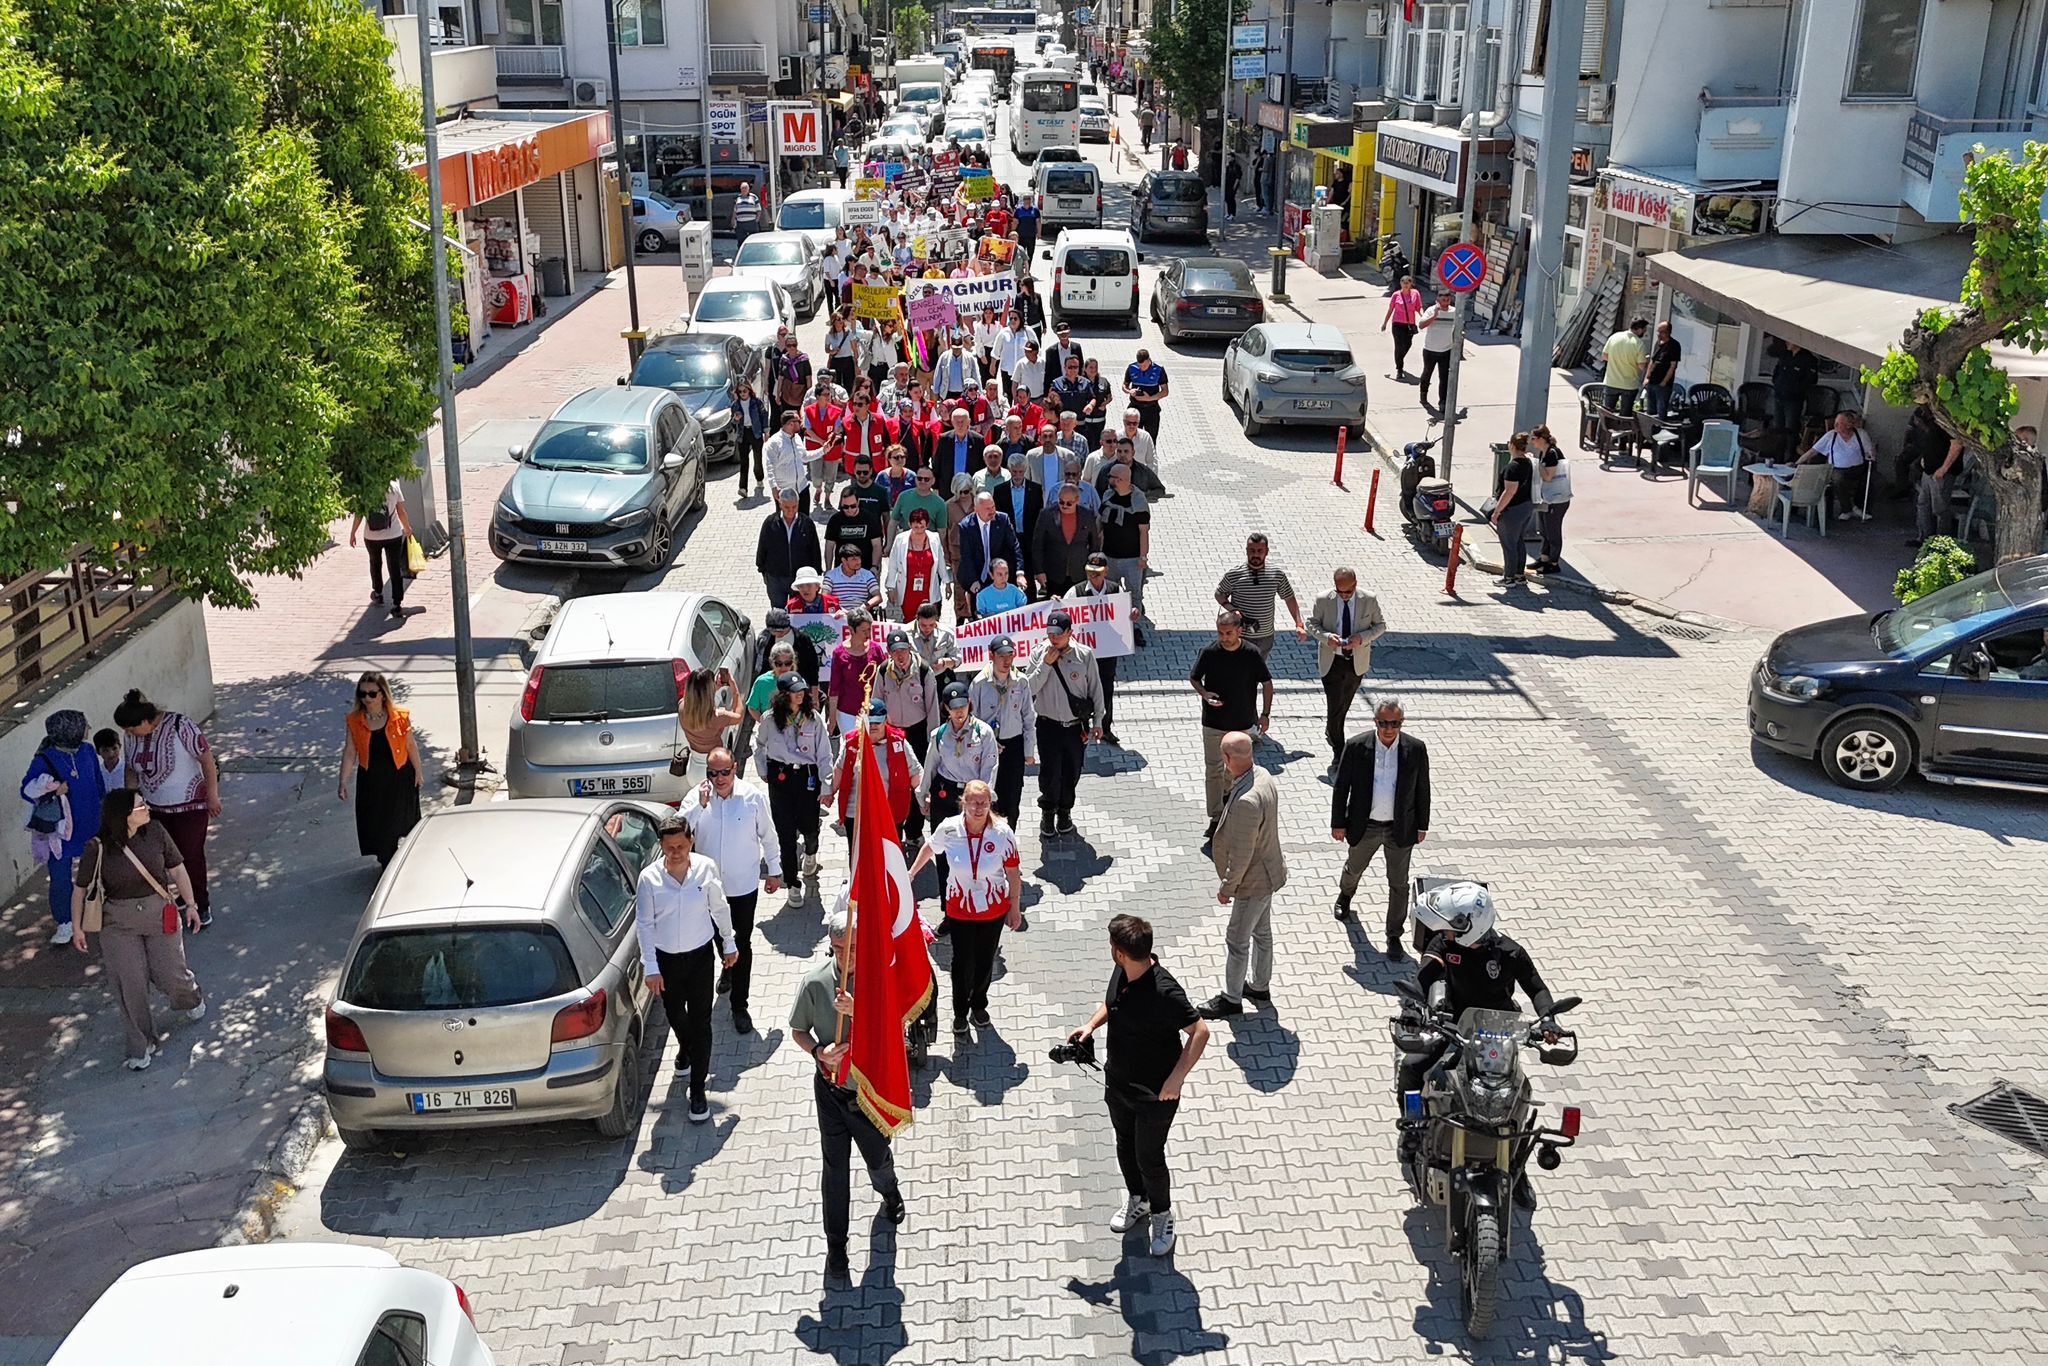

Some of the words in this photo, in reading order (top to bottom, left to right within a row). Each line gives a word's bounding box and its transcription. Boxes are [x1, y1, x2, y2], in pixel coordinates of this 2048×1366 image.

[709, 109, 737, 119] OGÜN
[711, 122, 736, 130] SPOT
[783, 112, 817, 143] M
[1382, 136, 1421, 167] TANDIRDA
[1421, 145, 1450, 181] LAVAŞ
[934, 278, 1013, 297] AĞNUR
[555, 523, 570, 534] FIAT
[543, 541, 552, 549] 35
[571, 542, 585, 551] 332
[1006, 612, 1048, 633] İHLAL
[1052, 602, 1115, 626] MEYİN
[581, 779, 595, 791] 45
[601, 778, 616, 790] HR
[622, 777, 644, 789] 565
[425, 1092, 442, 1107] 16
[453, 1090, 471, 1106] ZH
[483, 1090, 510, 1104] 826
